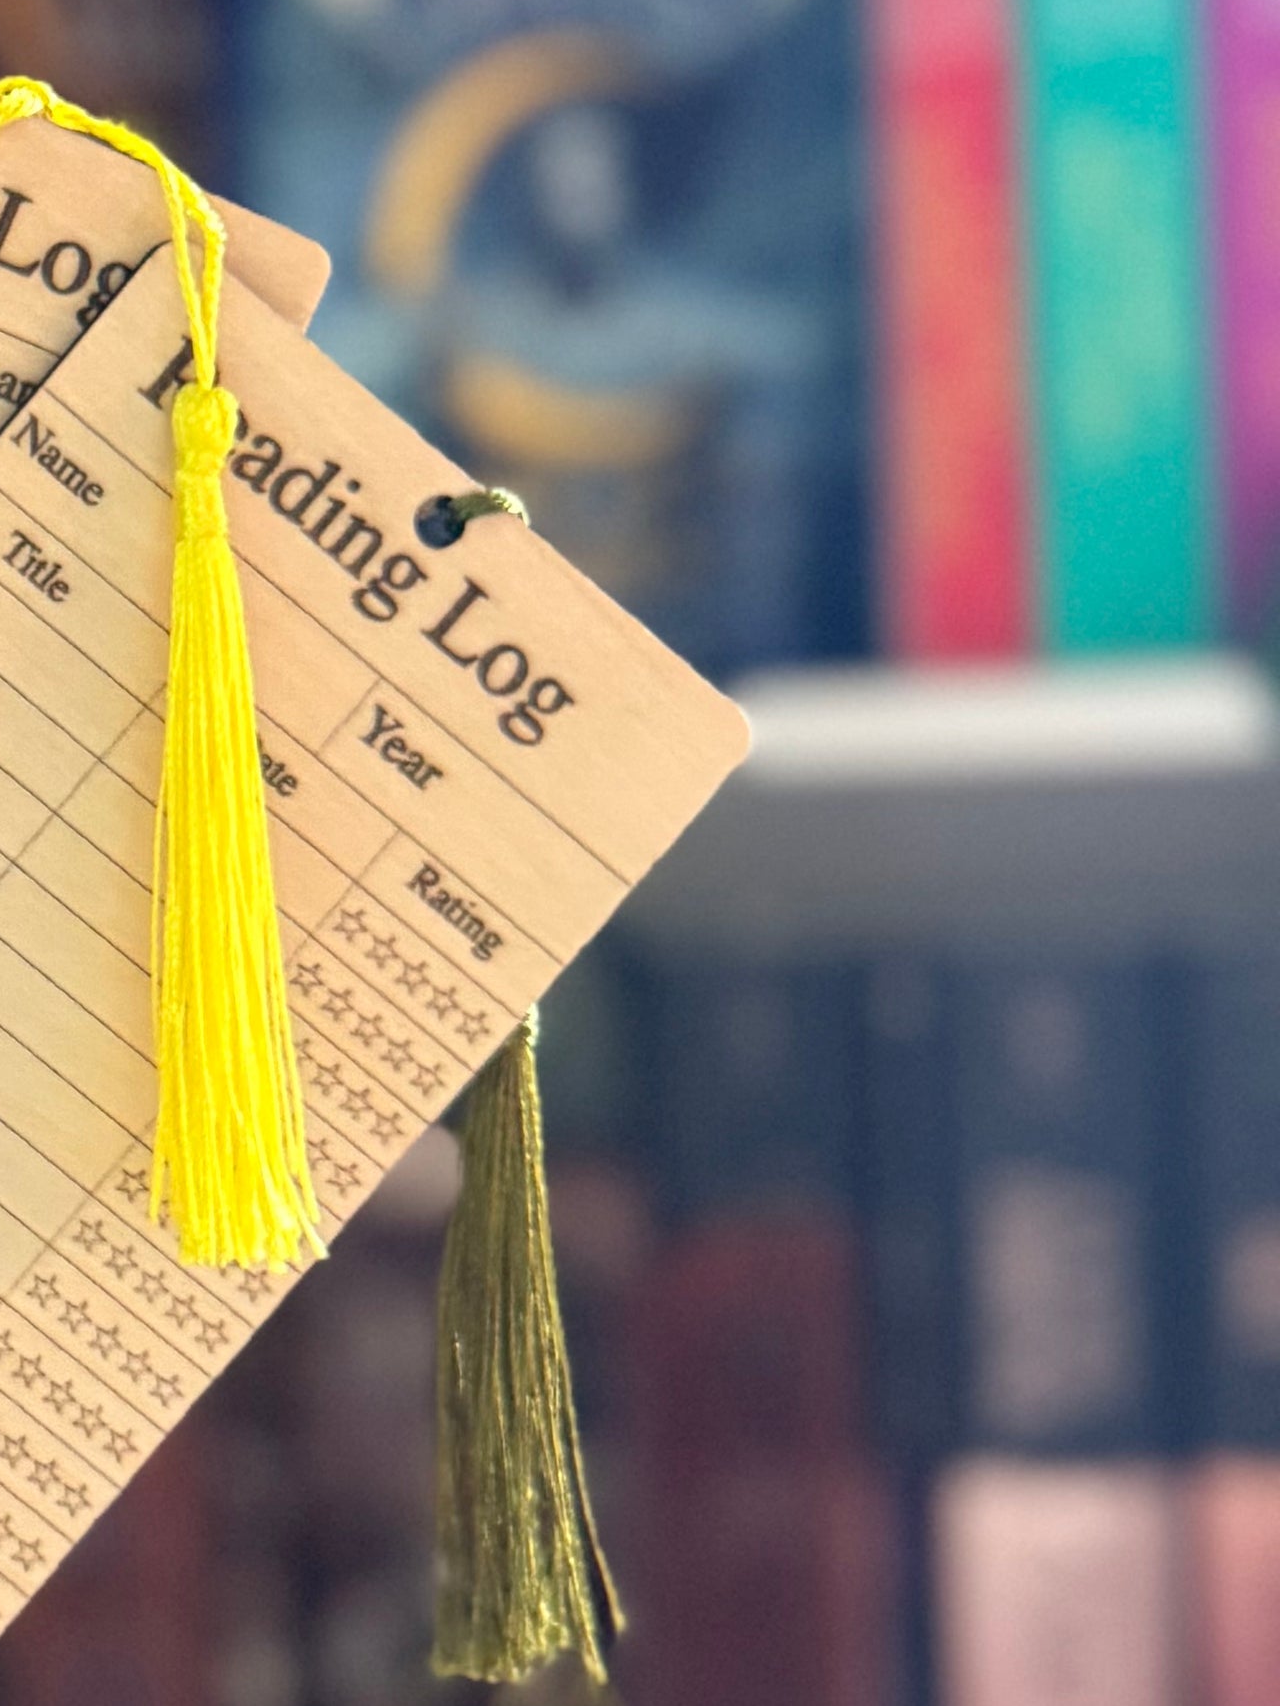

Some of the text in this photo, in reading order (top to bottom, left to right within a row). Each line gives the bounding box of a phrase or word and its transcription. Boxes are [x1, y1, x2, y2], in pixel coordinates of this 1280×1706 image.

[10, 412, 105, 507] Name
[2, 529, 71, 603] Title
[137, 334, 576, 746] Rading Log
[256, 733, 298, 797] ate
[359, 703, 444, 790] Year
[405, 861, 504, 961] Rating
